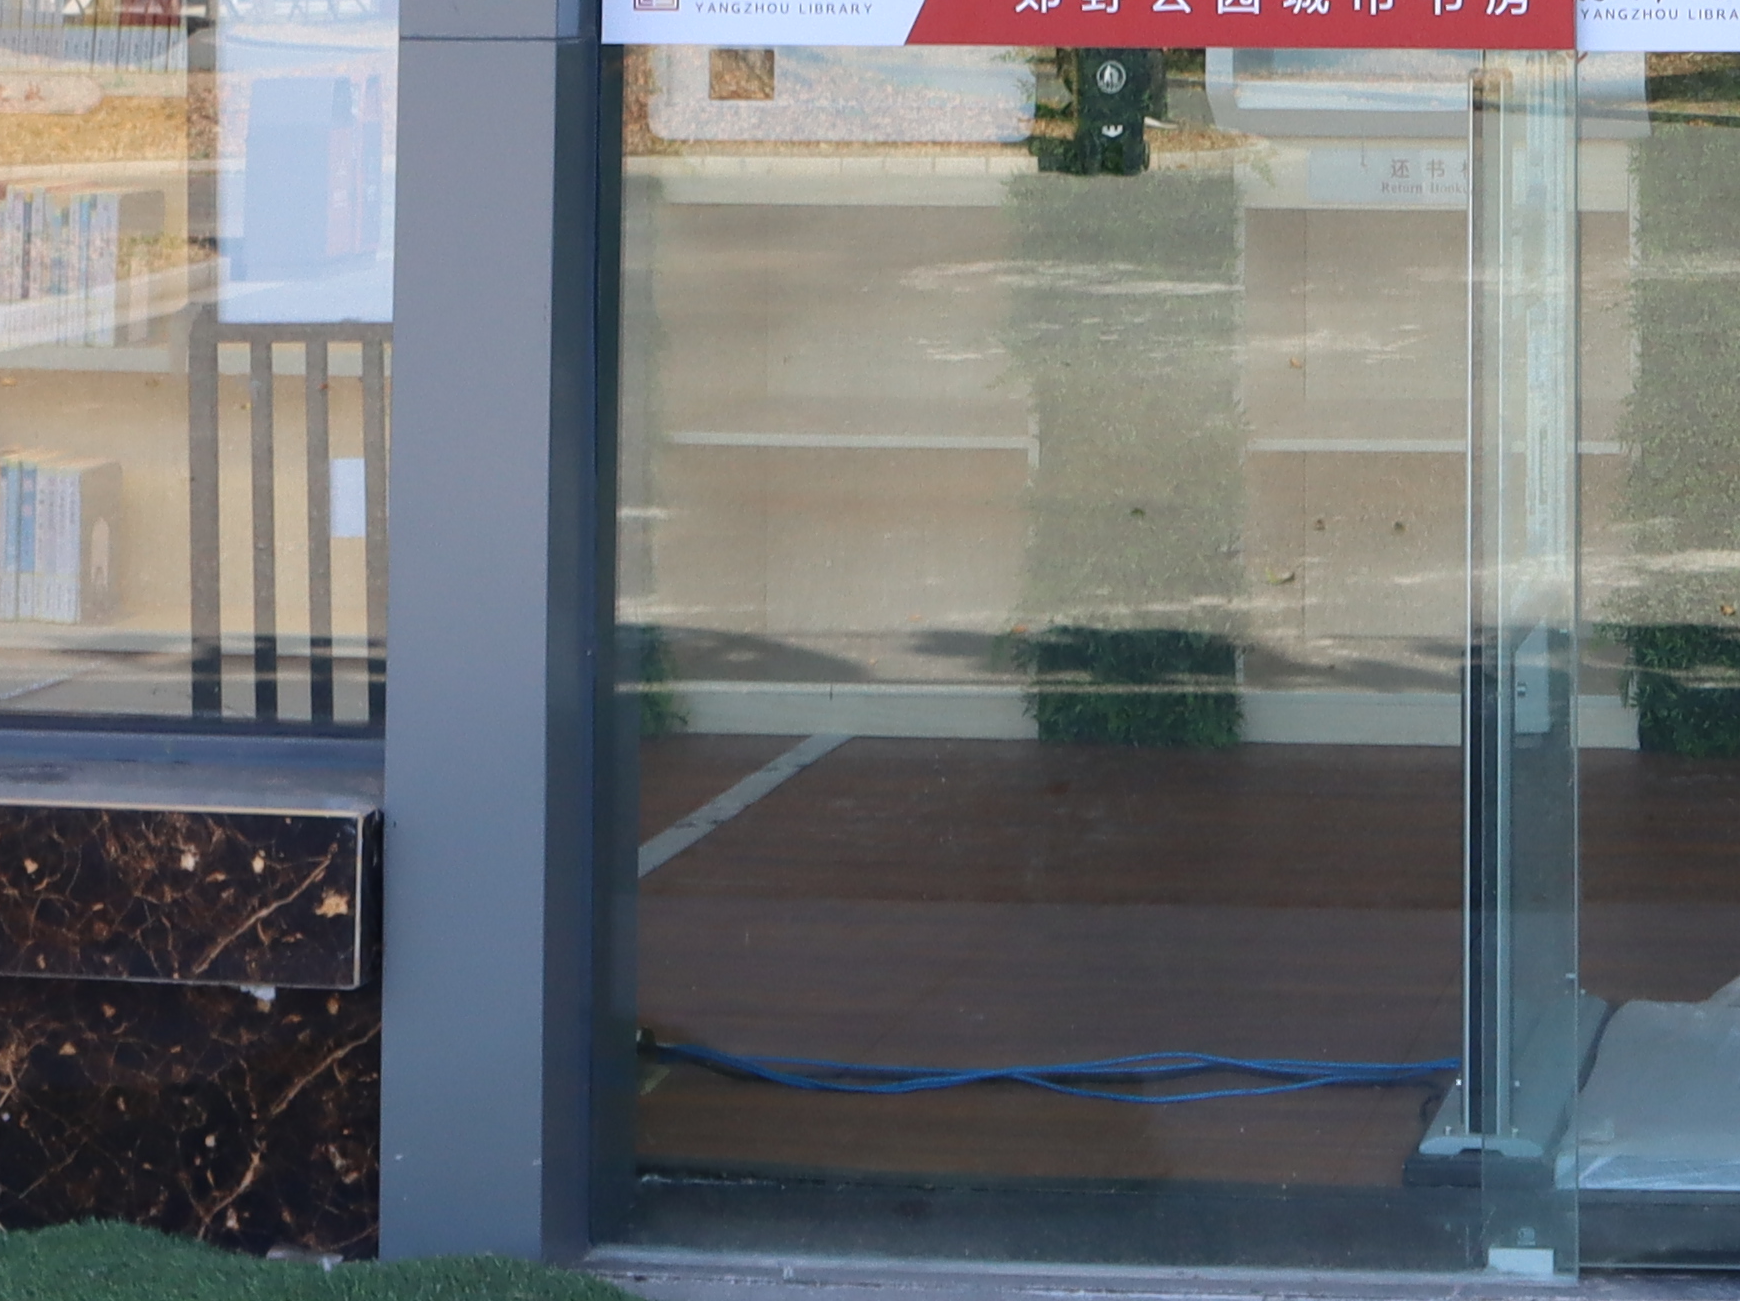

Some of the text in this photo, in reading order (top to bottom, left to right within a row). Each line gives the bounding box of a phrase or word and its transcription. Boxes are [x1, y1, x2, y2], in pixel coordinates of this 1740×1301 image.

[695, 1, 875, 15] YANGZHOU LIBRARY
[1580, 8, 1681, 21] YANGZHOU
[1381, 182, 1423, 195] Return
